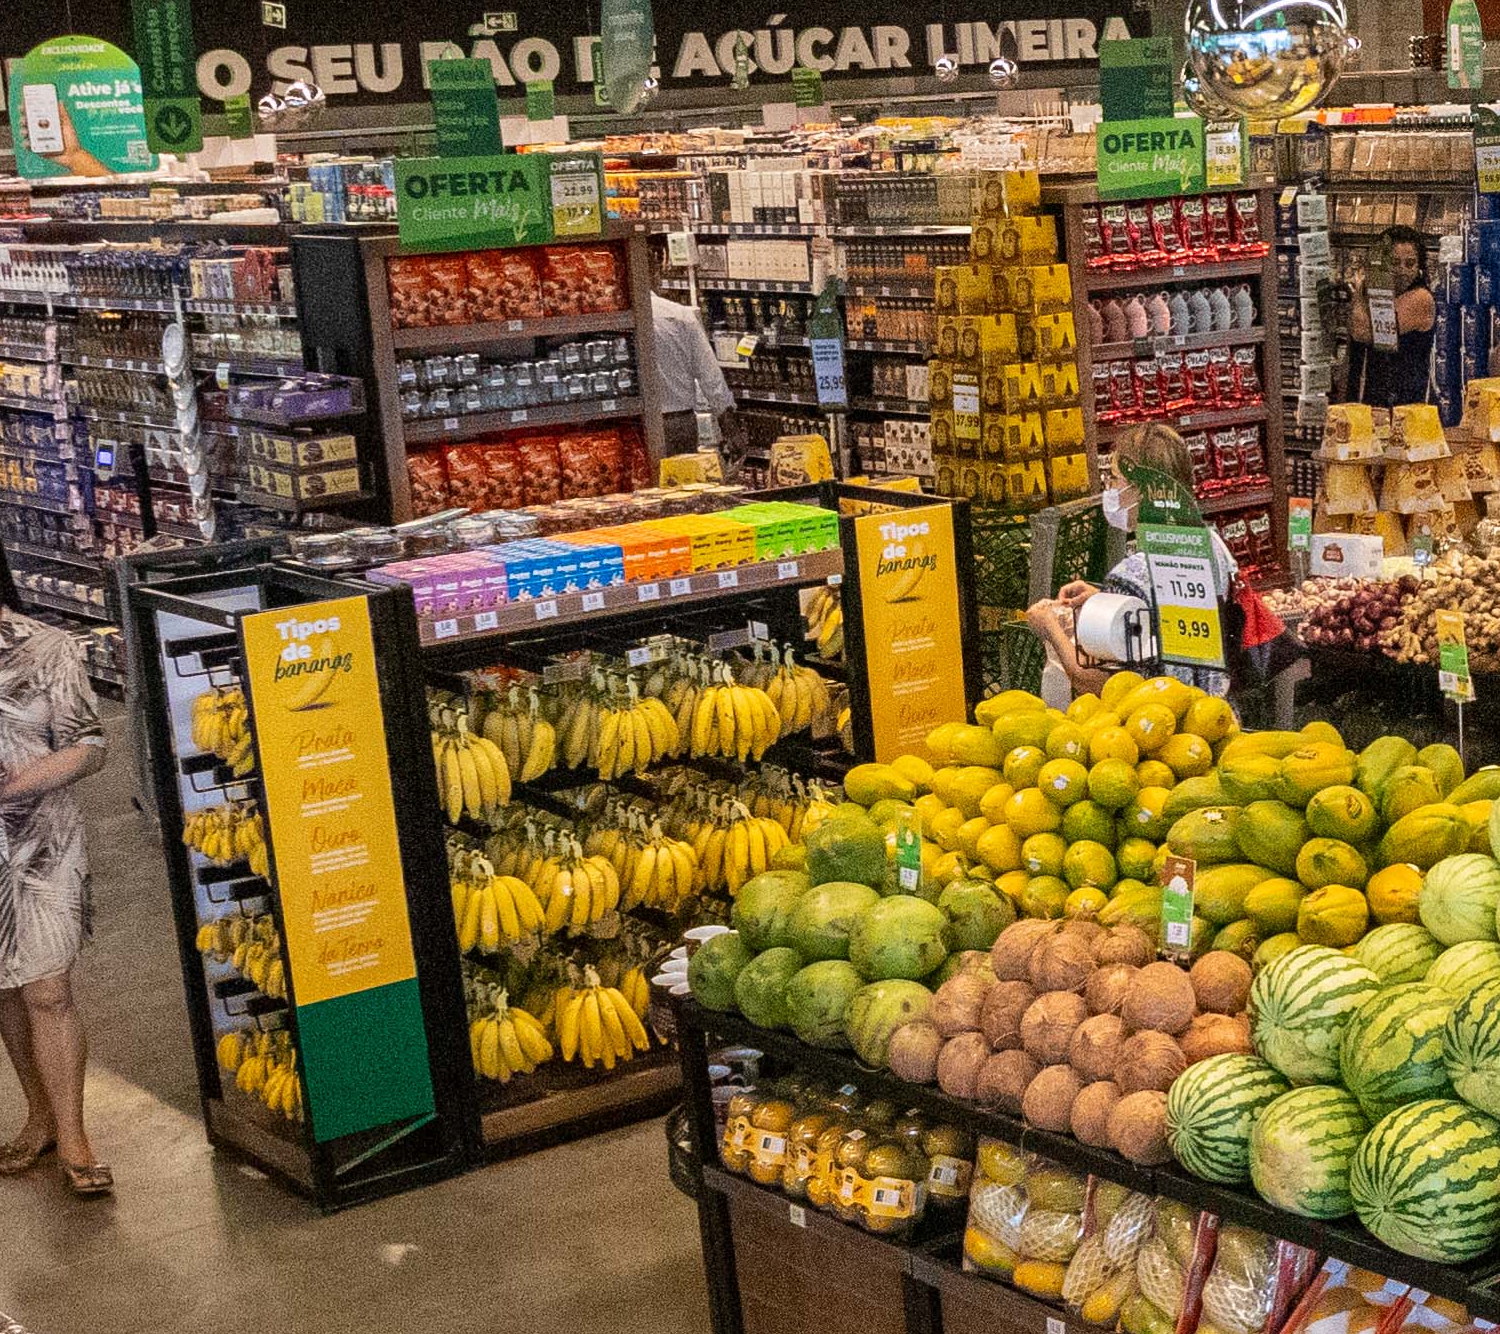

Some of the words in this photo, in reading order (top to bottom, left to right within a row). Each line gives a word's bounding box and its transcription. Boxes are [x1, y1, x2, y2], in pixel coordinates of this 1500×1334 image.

[267, 43, 404, 97] SEU
[672, 13, 911, 79] AÇÚCAR
[68, 82, 112, 97] Ative
[114, 80, 132, 98] já
[1103, 129, 1196, 154] OFERTA
[1108, 161, 1149, 174] Cliente
[404, 171, 530, 199] OFERTA
[412, 207, 468, 222] Cliente
[473, 199, 520, 223] Mais
[879, 522, 930, 543] Tipos
[883, 543, 907, 560] de
[876, 553, 938, 578] bananas
[1169, 580, 1206, 600] 11,99
[276, 618, 340, 641] Tipos
[1177, 621, 1211, 640] 9,99
[282, 643, 311, 662] de
[274, 652, 353, 684] bananas
